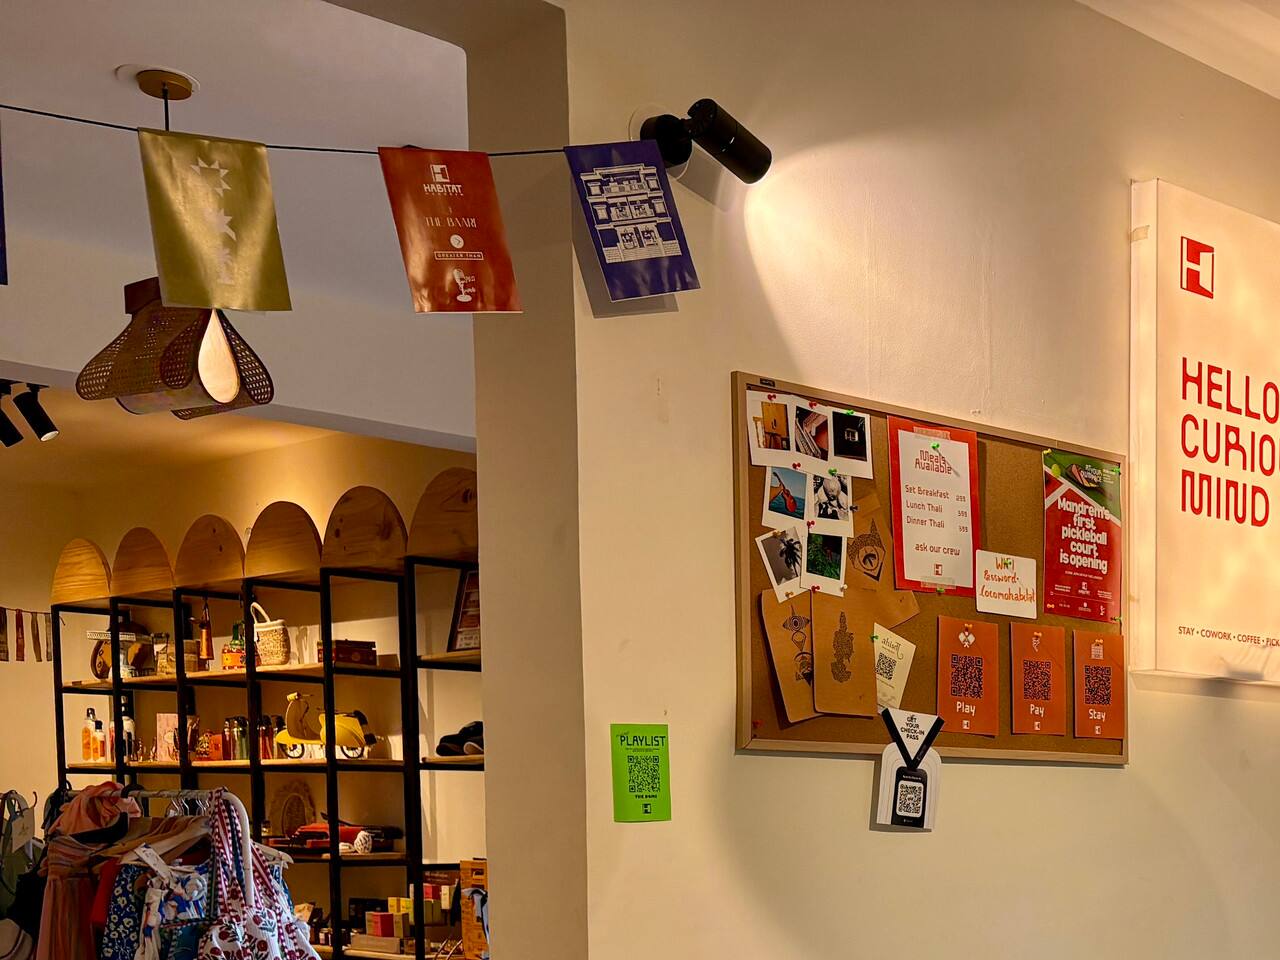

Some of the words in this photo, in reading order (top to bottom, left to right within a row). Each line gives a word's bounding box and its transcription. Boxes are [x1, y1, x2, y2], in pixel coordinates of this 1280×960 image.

[424, 184, 462, 193] HABITAT
[920, 450, 946, 463] Meals
[915, 458, 952, 475] Available
[917, 486, 949, 500] Breakfast
[1181, 468, 1270, 528] MIND
[906, 500, 926, 511] Lunch
[928, 503, 943, 513] Thali
[1057, 497, 1111, 520] Mandrem's
[906, 516, 927, 527] Dinner
[929, 518, 945, 528] Thali
[1072, 513, 1096, 530] first
[1061, 524, 1108, 545] pickleball
[915, 543, 928, 552] ask
[930, 545, 942, 554] our
[942, 547, 960, 556] crew
[1059, 548, 1070, 564] is
[1069, 553, 1108, 575] opening
[1178, 626, 1195, 636] STAY
[1200, 629, 1232, 641] COWORK
[1237, 633, 1261, 645] COFFEE
[956, 701, 976, 716] Play
[1030, 704, 1045, 717] Pay
[1088, 708, 1107, 722] Stay
[900, 726, 925, 736] CHECK-IN
[620, 735, 666, 747] PLAYLIST
